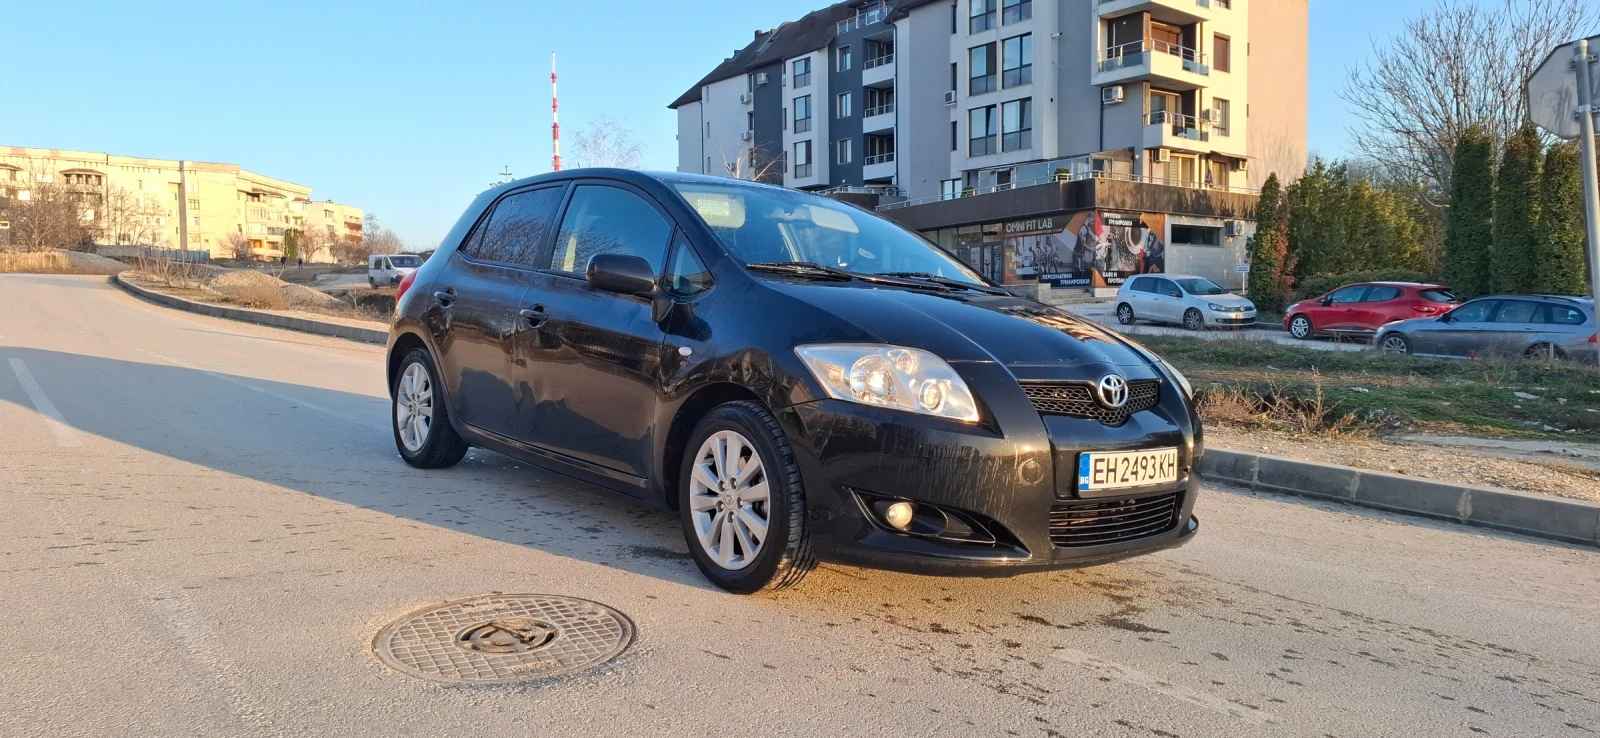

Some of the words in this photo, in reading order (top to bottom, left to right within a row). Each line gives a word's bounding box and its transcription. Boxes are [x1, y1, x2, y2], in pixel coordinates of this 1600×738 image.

[1005, 221, 1025, 233] OMNI
[1026, 220, 1037, 231] FIT
[1038, 218, 1053, 230] LAB
[1093, 458, 1118, 485] EH
[1120, 455, 1157, 482] 2493
[1159, 453, 1175, 479] KH
[1080, 476, 1089, 484] BG
